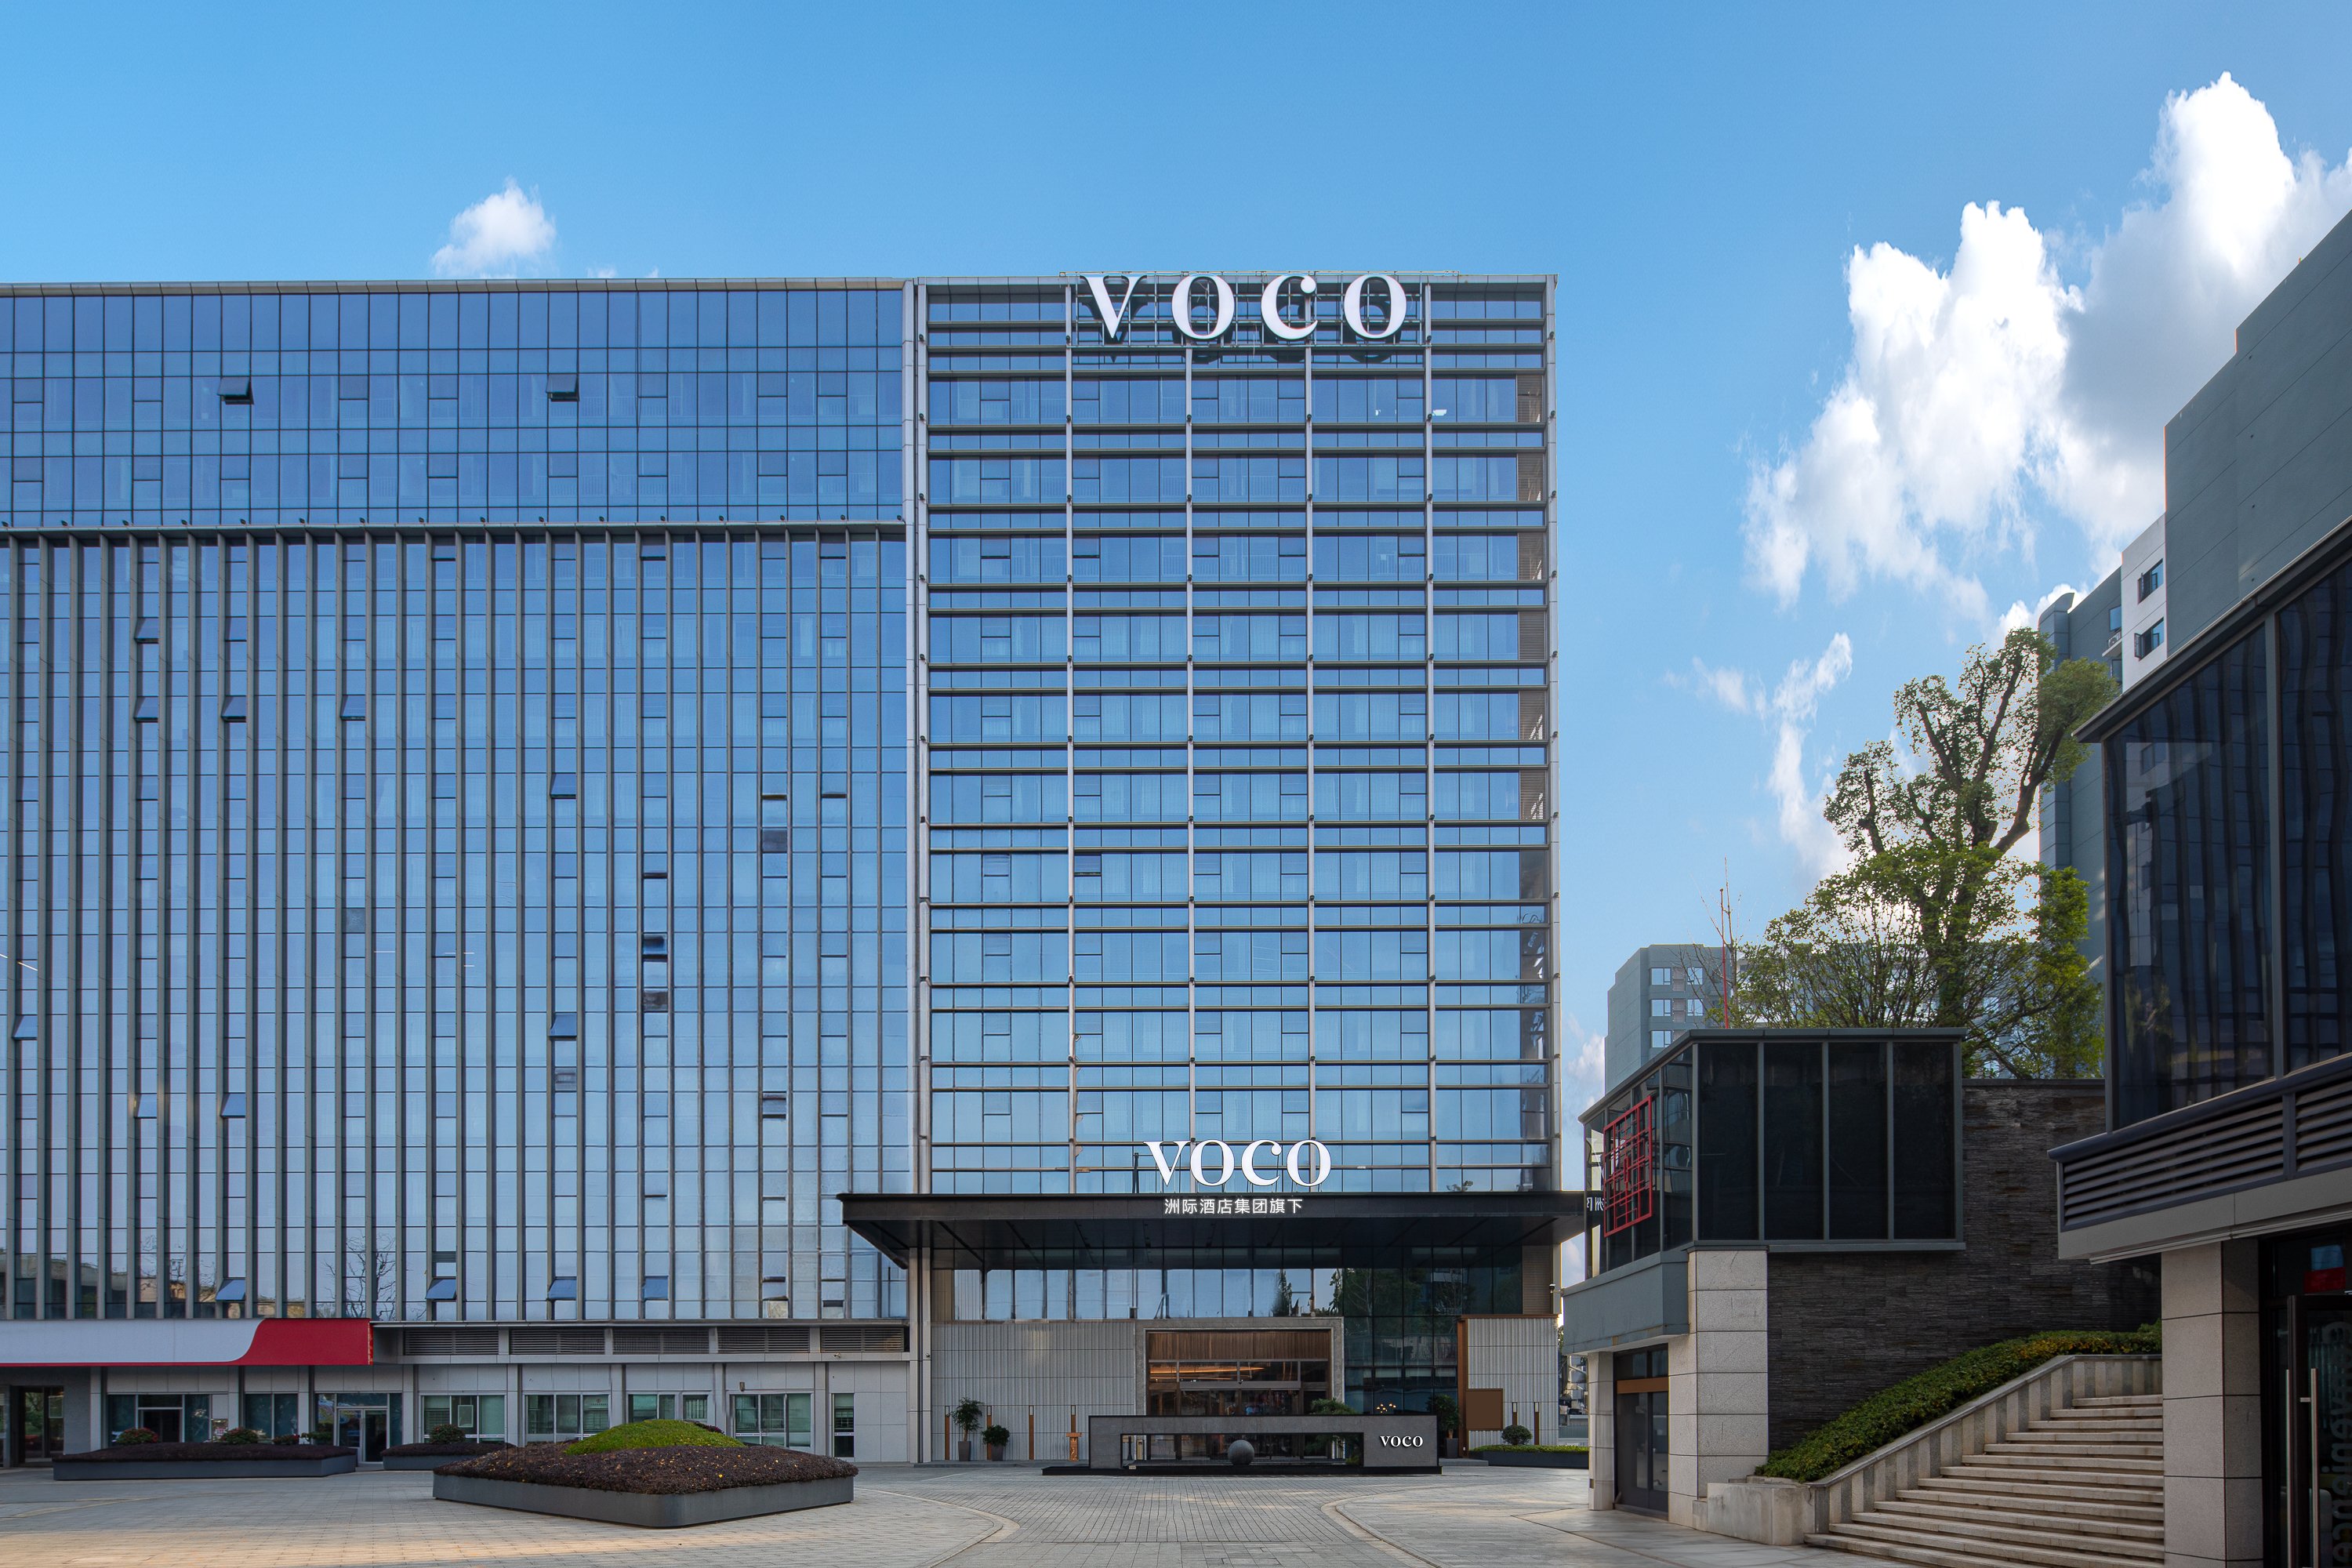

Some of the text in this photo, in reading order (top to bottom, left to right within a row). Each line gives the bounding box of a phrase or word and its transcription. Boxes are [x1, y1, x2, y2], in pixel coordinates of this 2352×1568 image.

[1164, 1198, 1303, 1214] 洲际酒店集团旗下
